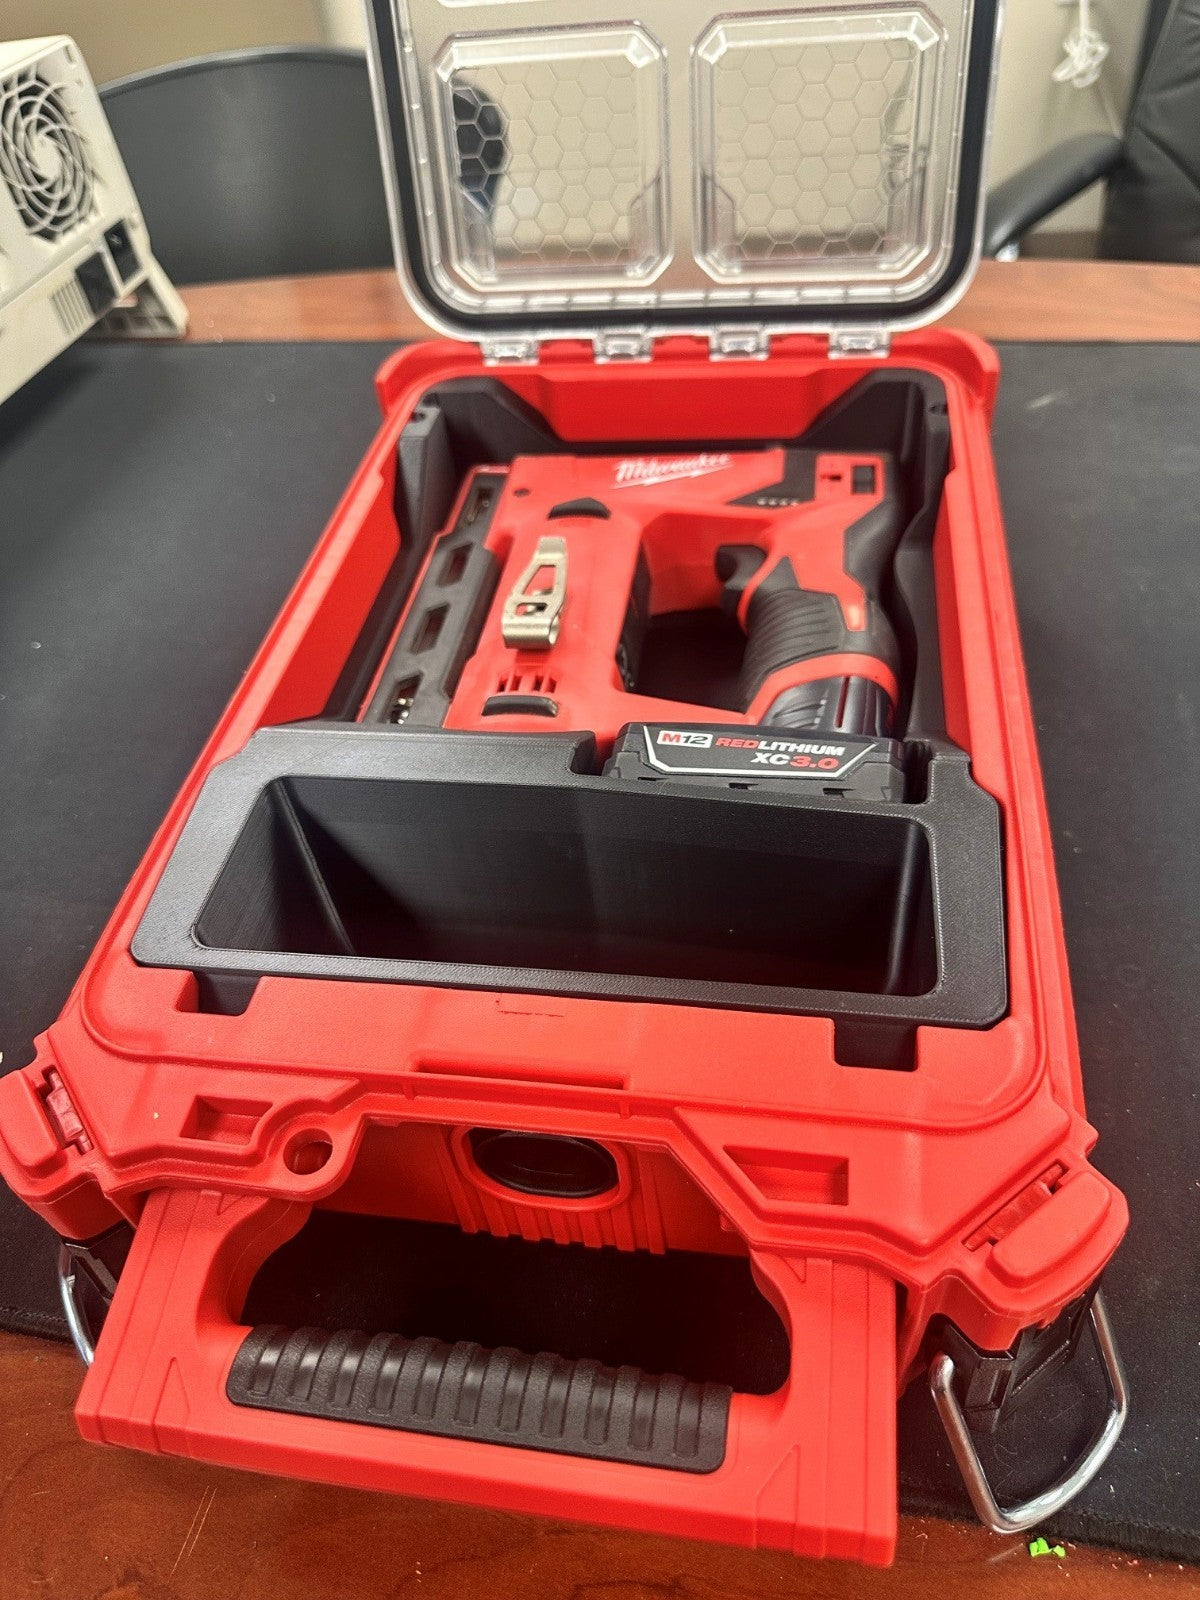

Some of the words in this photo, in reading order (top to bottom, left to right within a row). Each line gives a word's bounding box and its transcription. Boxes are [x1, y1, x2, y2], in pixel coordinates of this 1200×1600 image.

[614, 453, 730, 483] Milwaukee
[662, 733, 709, 745] M12
[715, 737, 846, 756] REDLITHIUM
[750, 752, 840, 770] XC3.0
